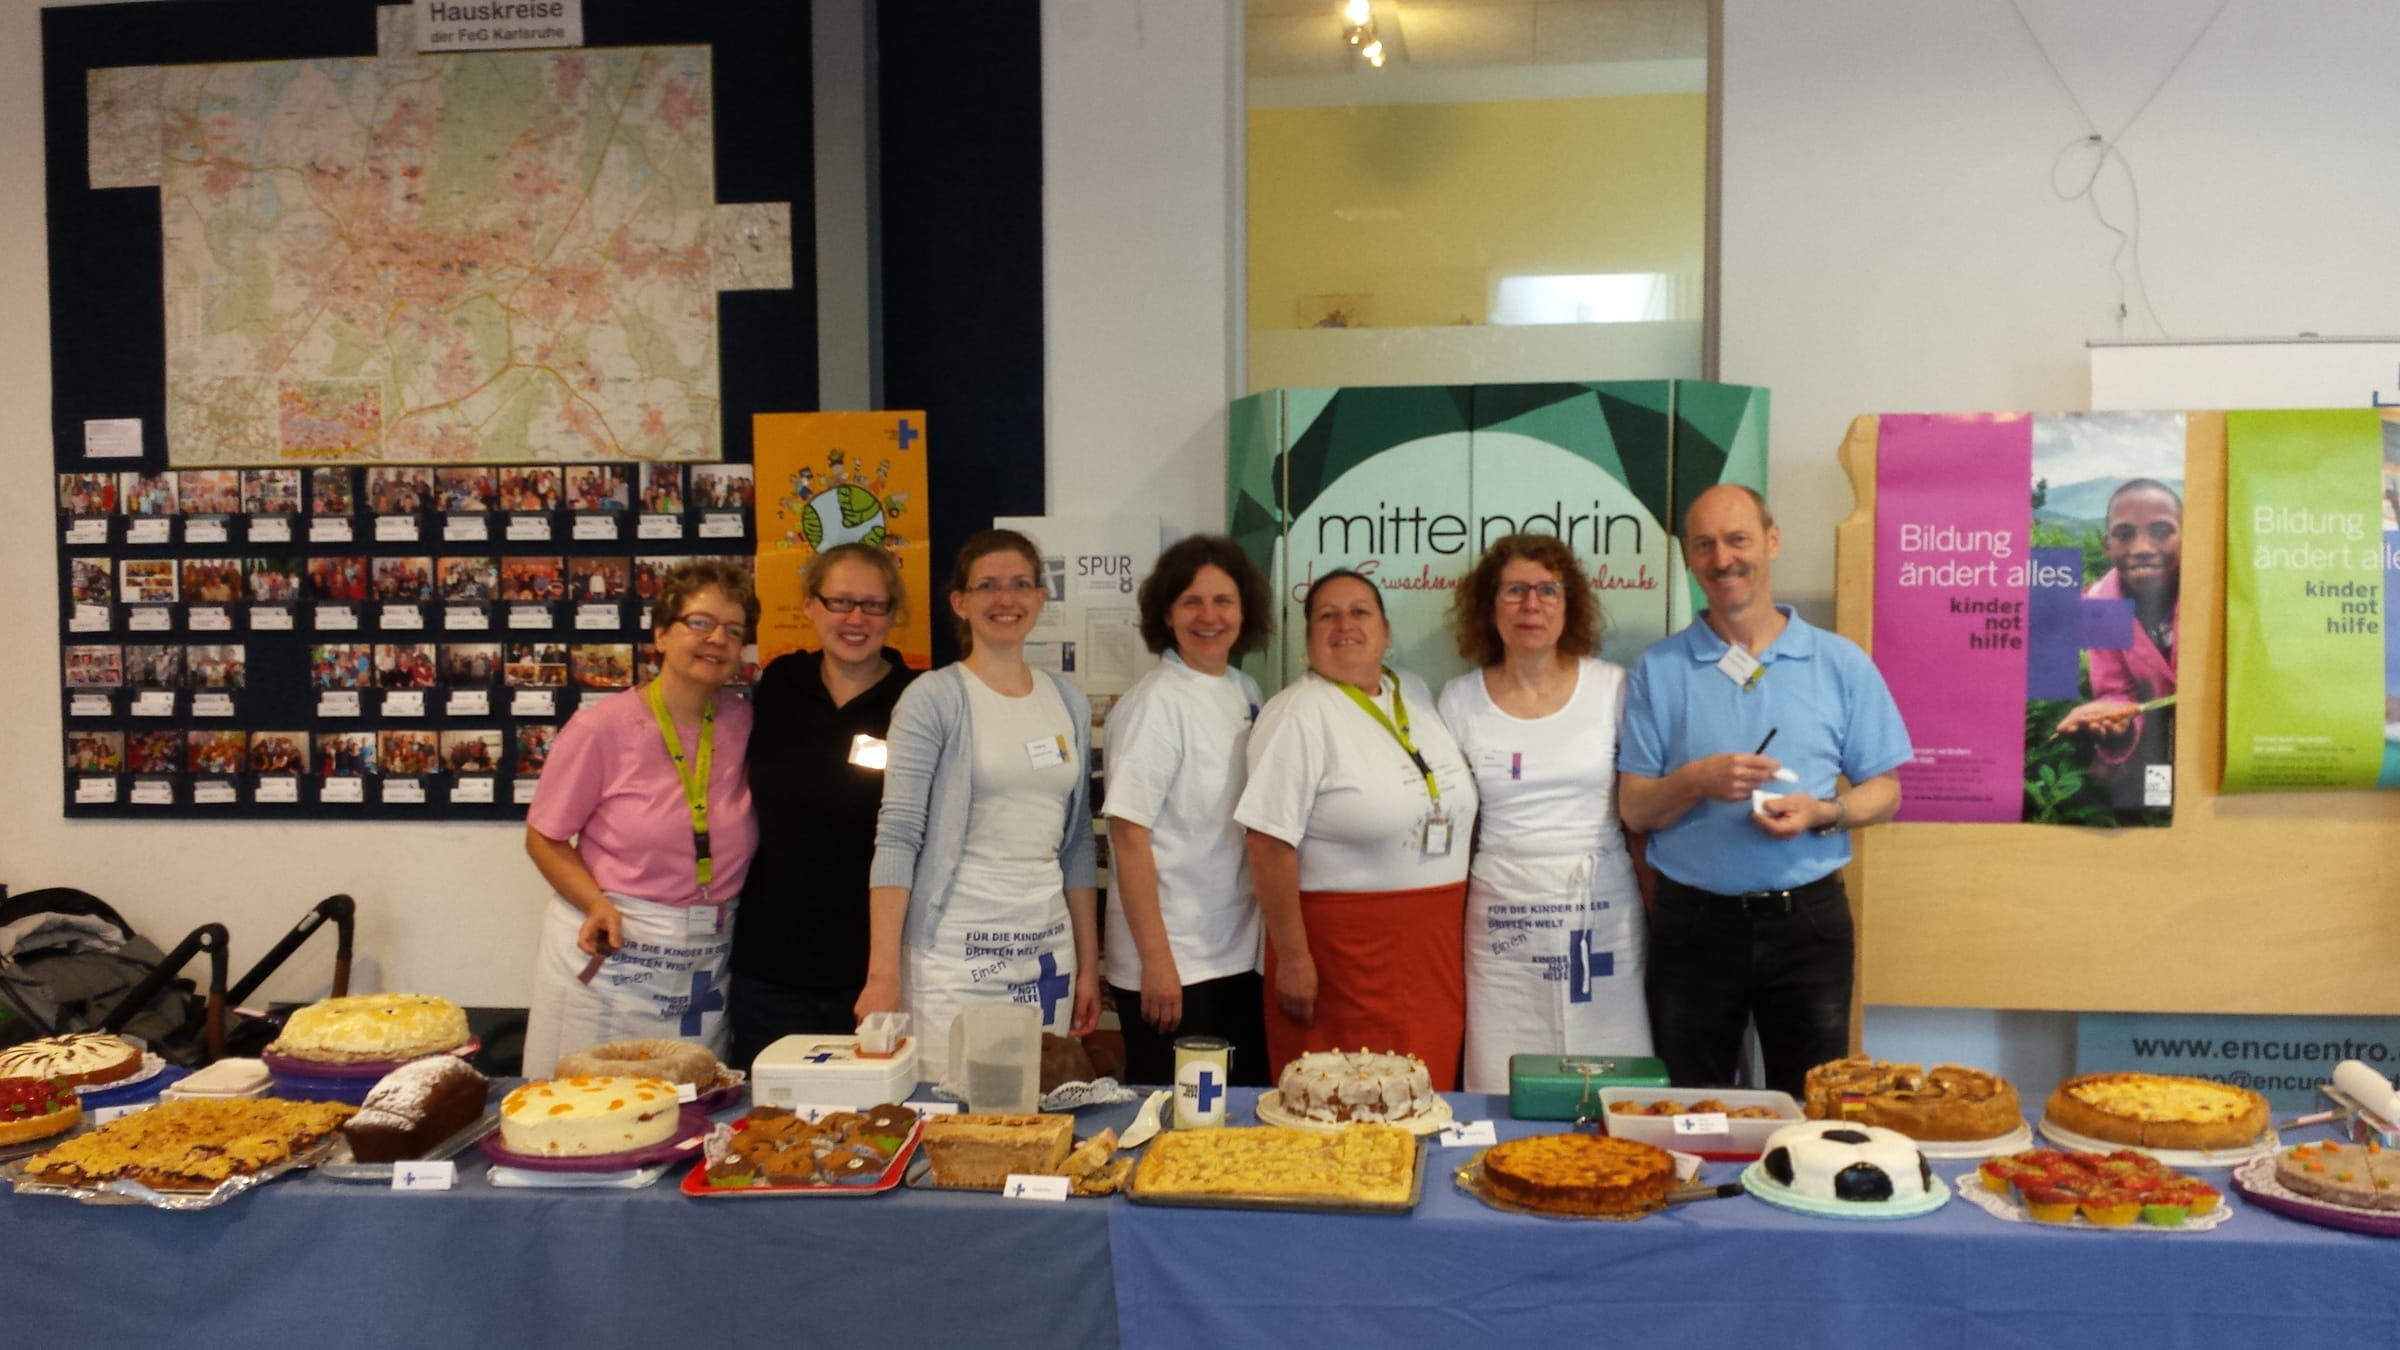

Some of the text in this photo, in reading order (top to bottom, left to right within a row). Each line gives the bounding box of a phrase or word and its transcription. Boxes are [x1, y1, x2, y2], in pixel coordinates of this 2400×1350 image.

[430, 0, 563, 22] Hauskreise
[431, 26, 565, 43] der FeG Karlsruhe
[2253, 505, 2365, 541] Bildung
[1900, 523, 2012, 558] Bildung
[2253, 542, 2352, 570] ändert
[1078, 556, 1132, 576] SPUR
[1898, 559, 2079, 588] ändert alles.
[2306, 581, 2378, 597] kinder
[1950, 598, 2023, 614] kinder
[2342, 600, 2378, 614] not
[1985, 616, 2022, 630] not
[2327, 617, 2379, 634] hilfe
[1969, 633, 2022, 649] hilfe
[1510, 906, 1527, 914] DIE
[1530, 904, 1572, 914] KINDER
[1535, 919, 1564, 928] WELT
[966, 930, 988, 941] FÜR
[992, 932, 1010, 941] DIE
[641, 943, 660, 953] DIE
[664, 947, 702, 957] KINDER
[971, 960, 1007, 983] Einen
